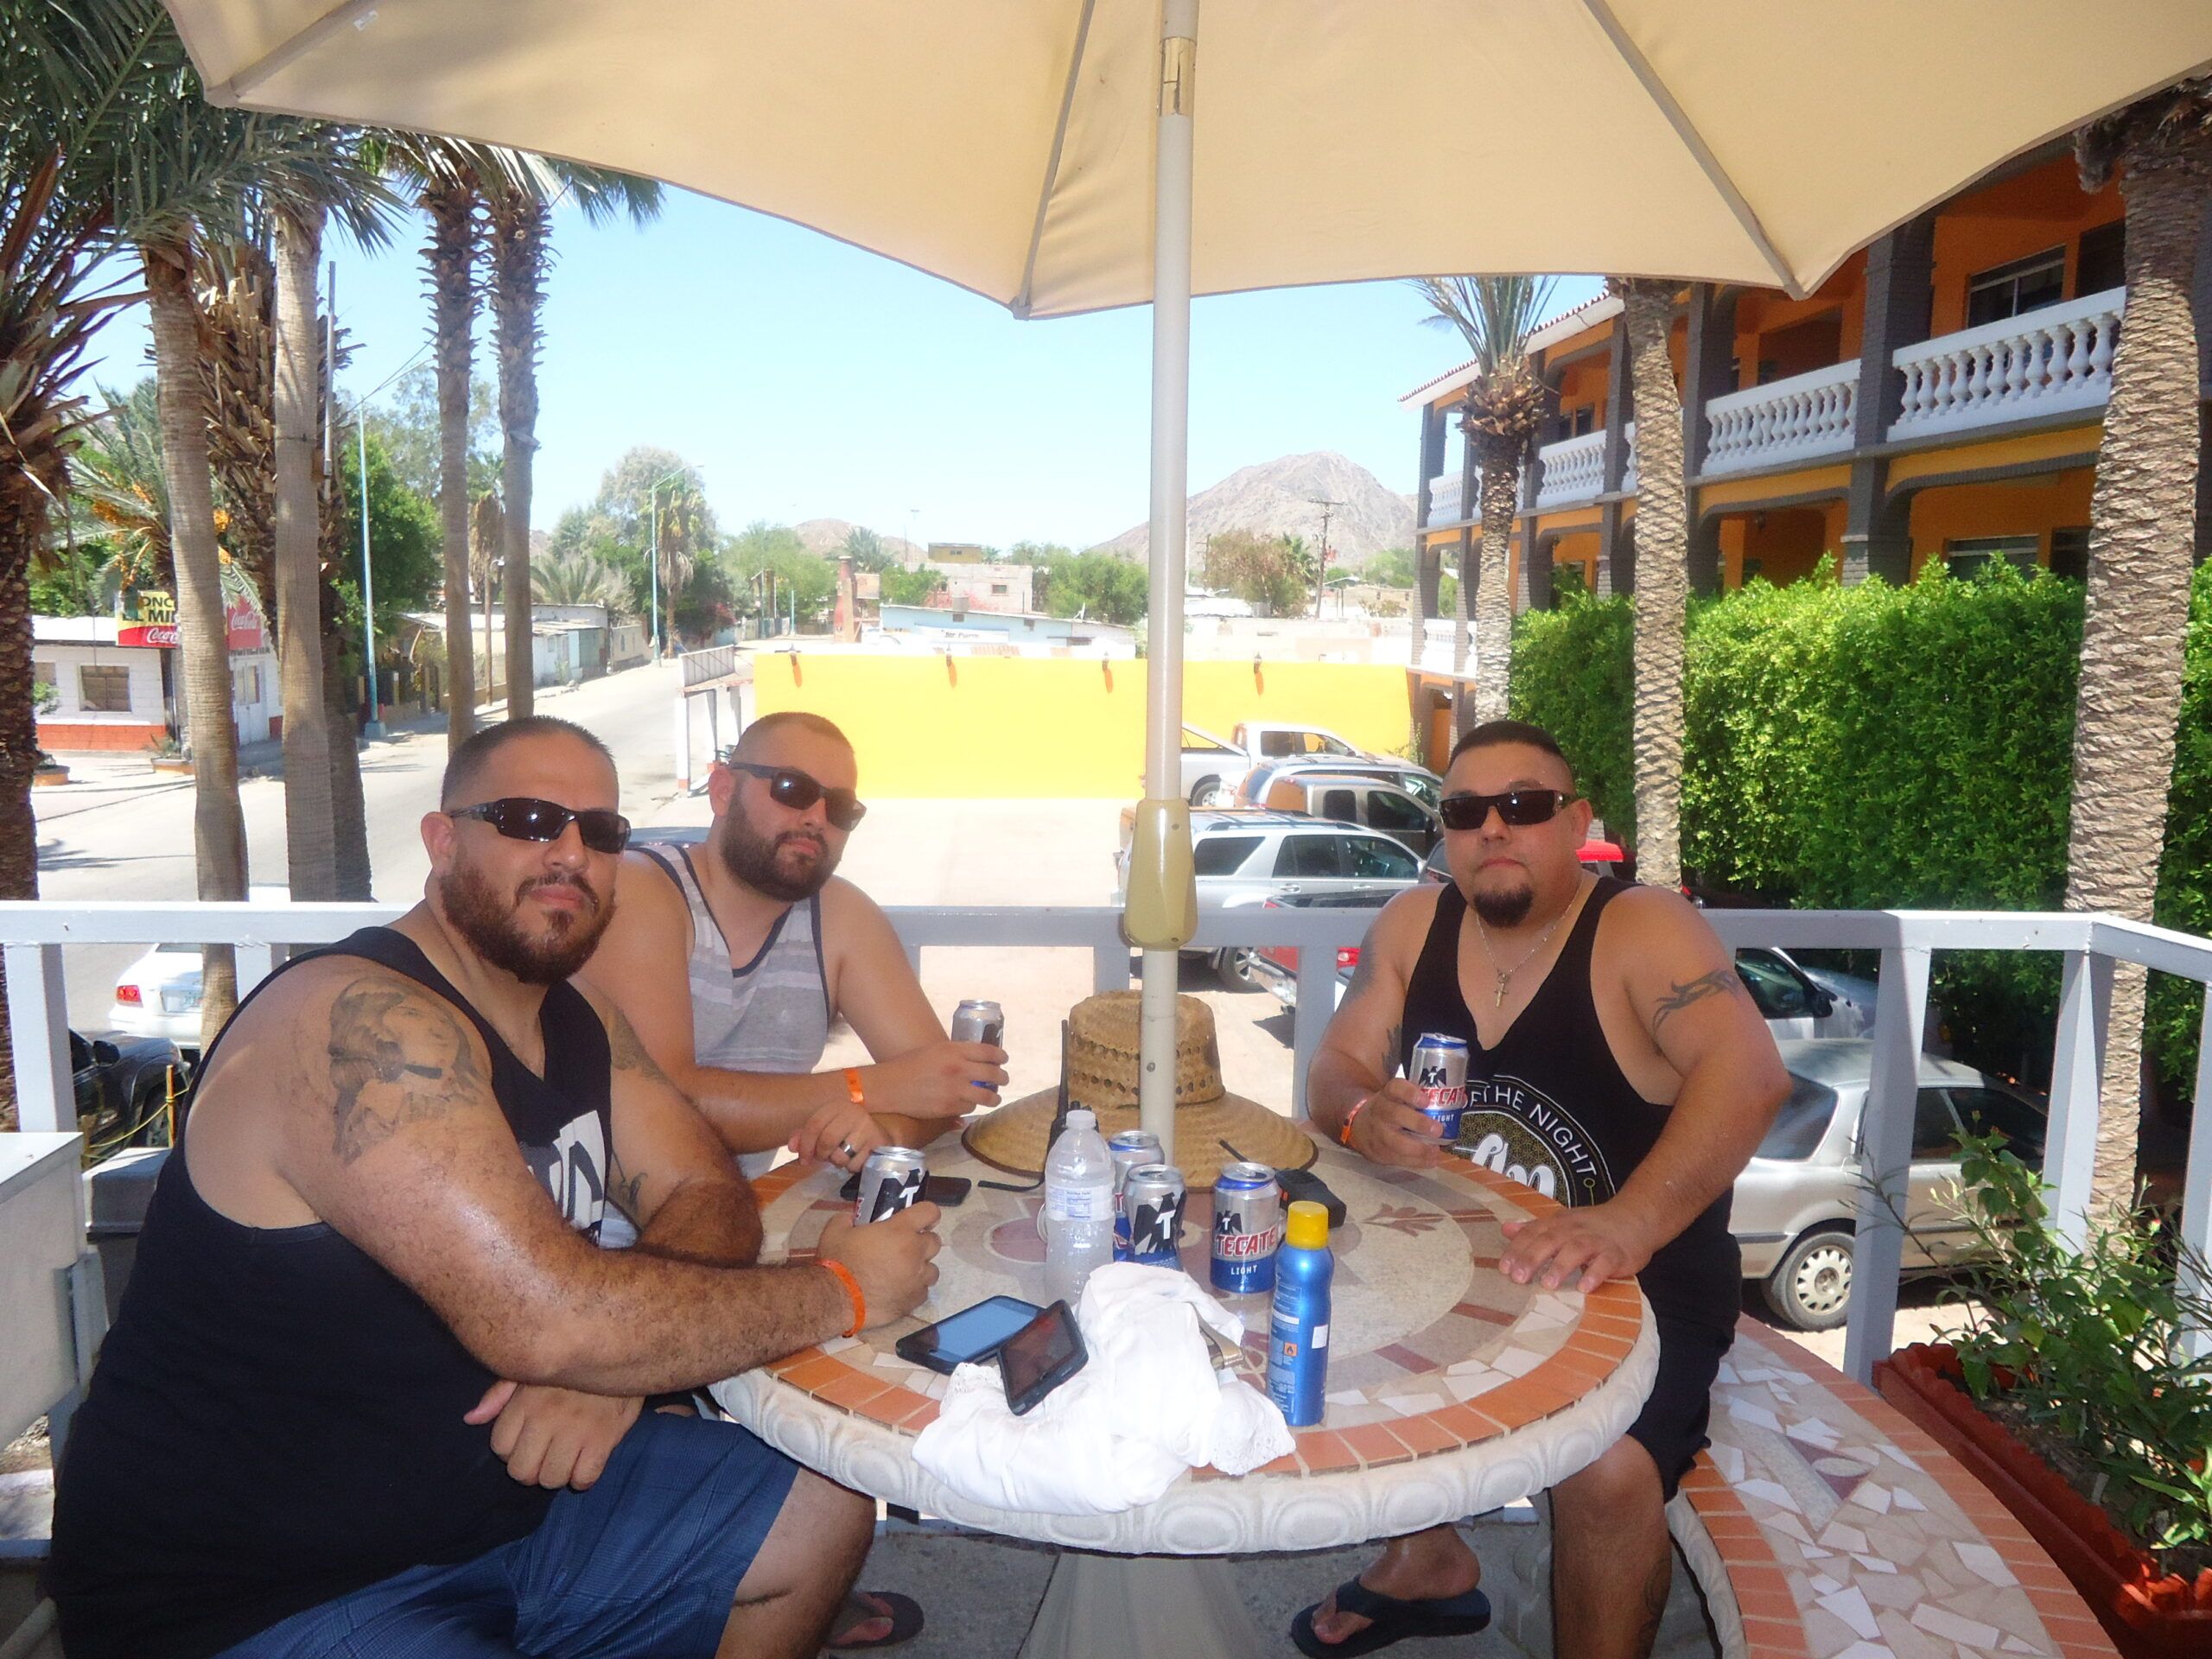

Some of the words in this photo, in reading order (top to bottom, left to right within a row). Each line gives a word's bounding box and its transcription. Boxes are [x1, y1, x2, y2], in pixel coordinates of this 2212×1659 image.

[1428, 1072, 1437, 1084] T
[1529, 1103, 1597, 1176] NIGHT
[899, 1185, 920, 1209] T
[1155, 1209, 1176, 1239] T
[1222, 1217, 1230, 1230] T
[1216, 1224, 1277, 1256] TECATE
[1230, 1265, 1257, 1275] LIGHT
